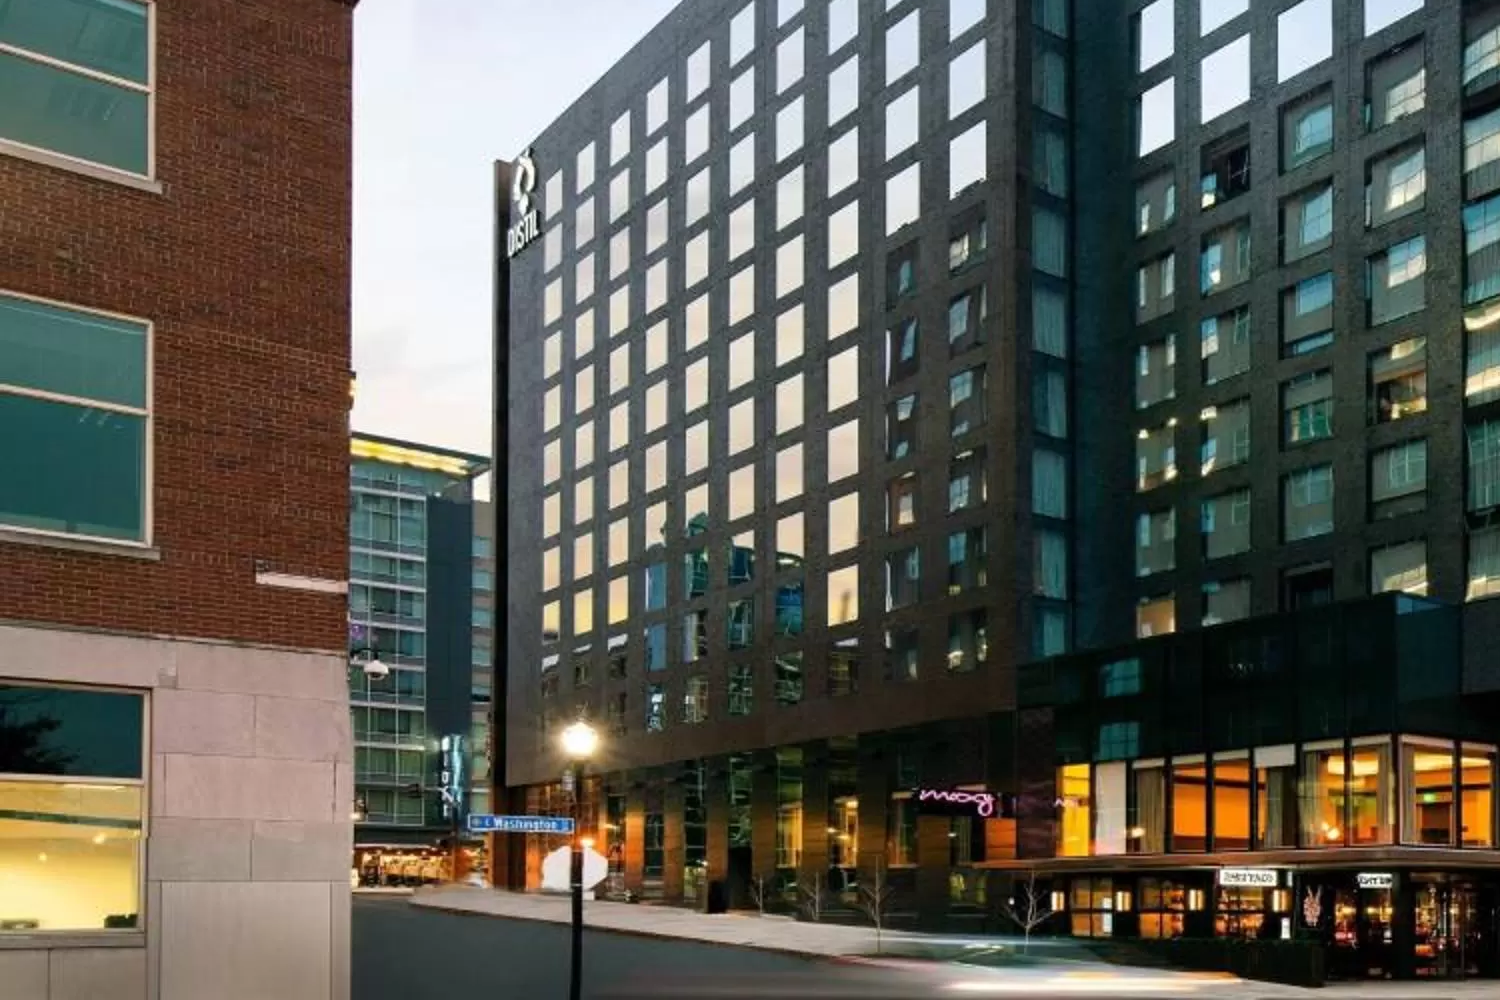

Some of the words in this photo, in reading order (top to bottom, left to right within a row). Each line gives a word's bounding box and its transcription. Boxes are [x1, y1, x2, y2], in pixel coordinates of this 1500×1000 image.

[507, 209, 540, 257] DISTIL
[918, 789, 996, 817] moxy
[493, 818, 558, 831] Washington
